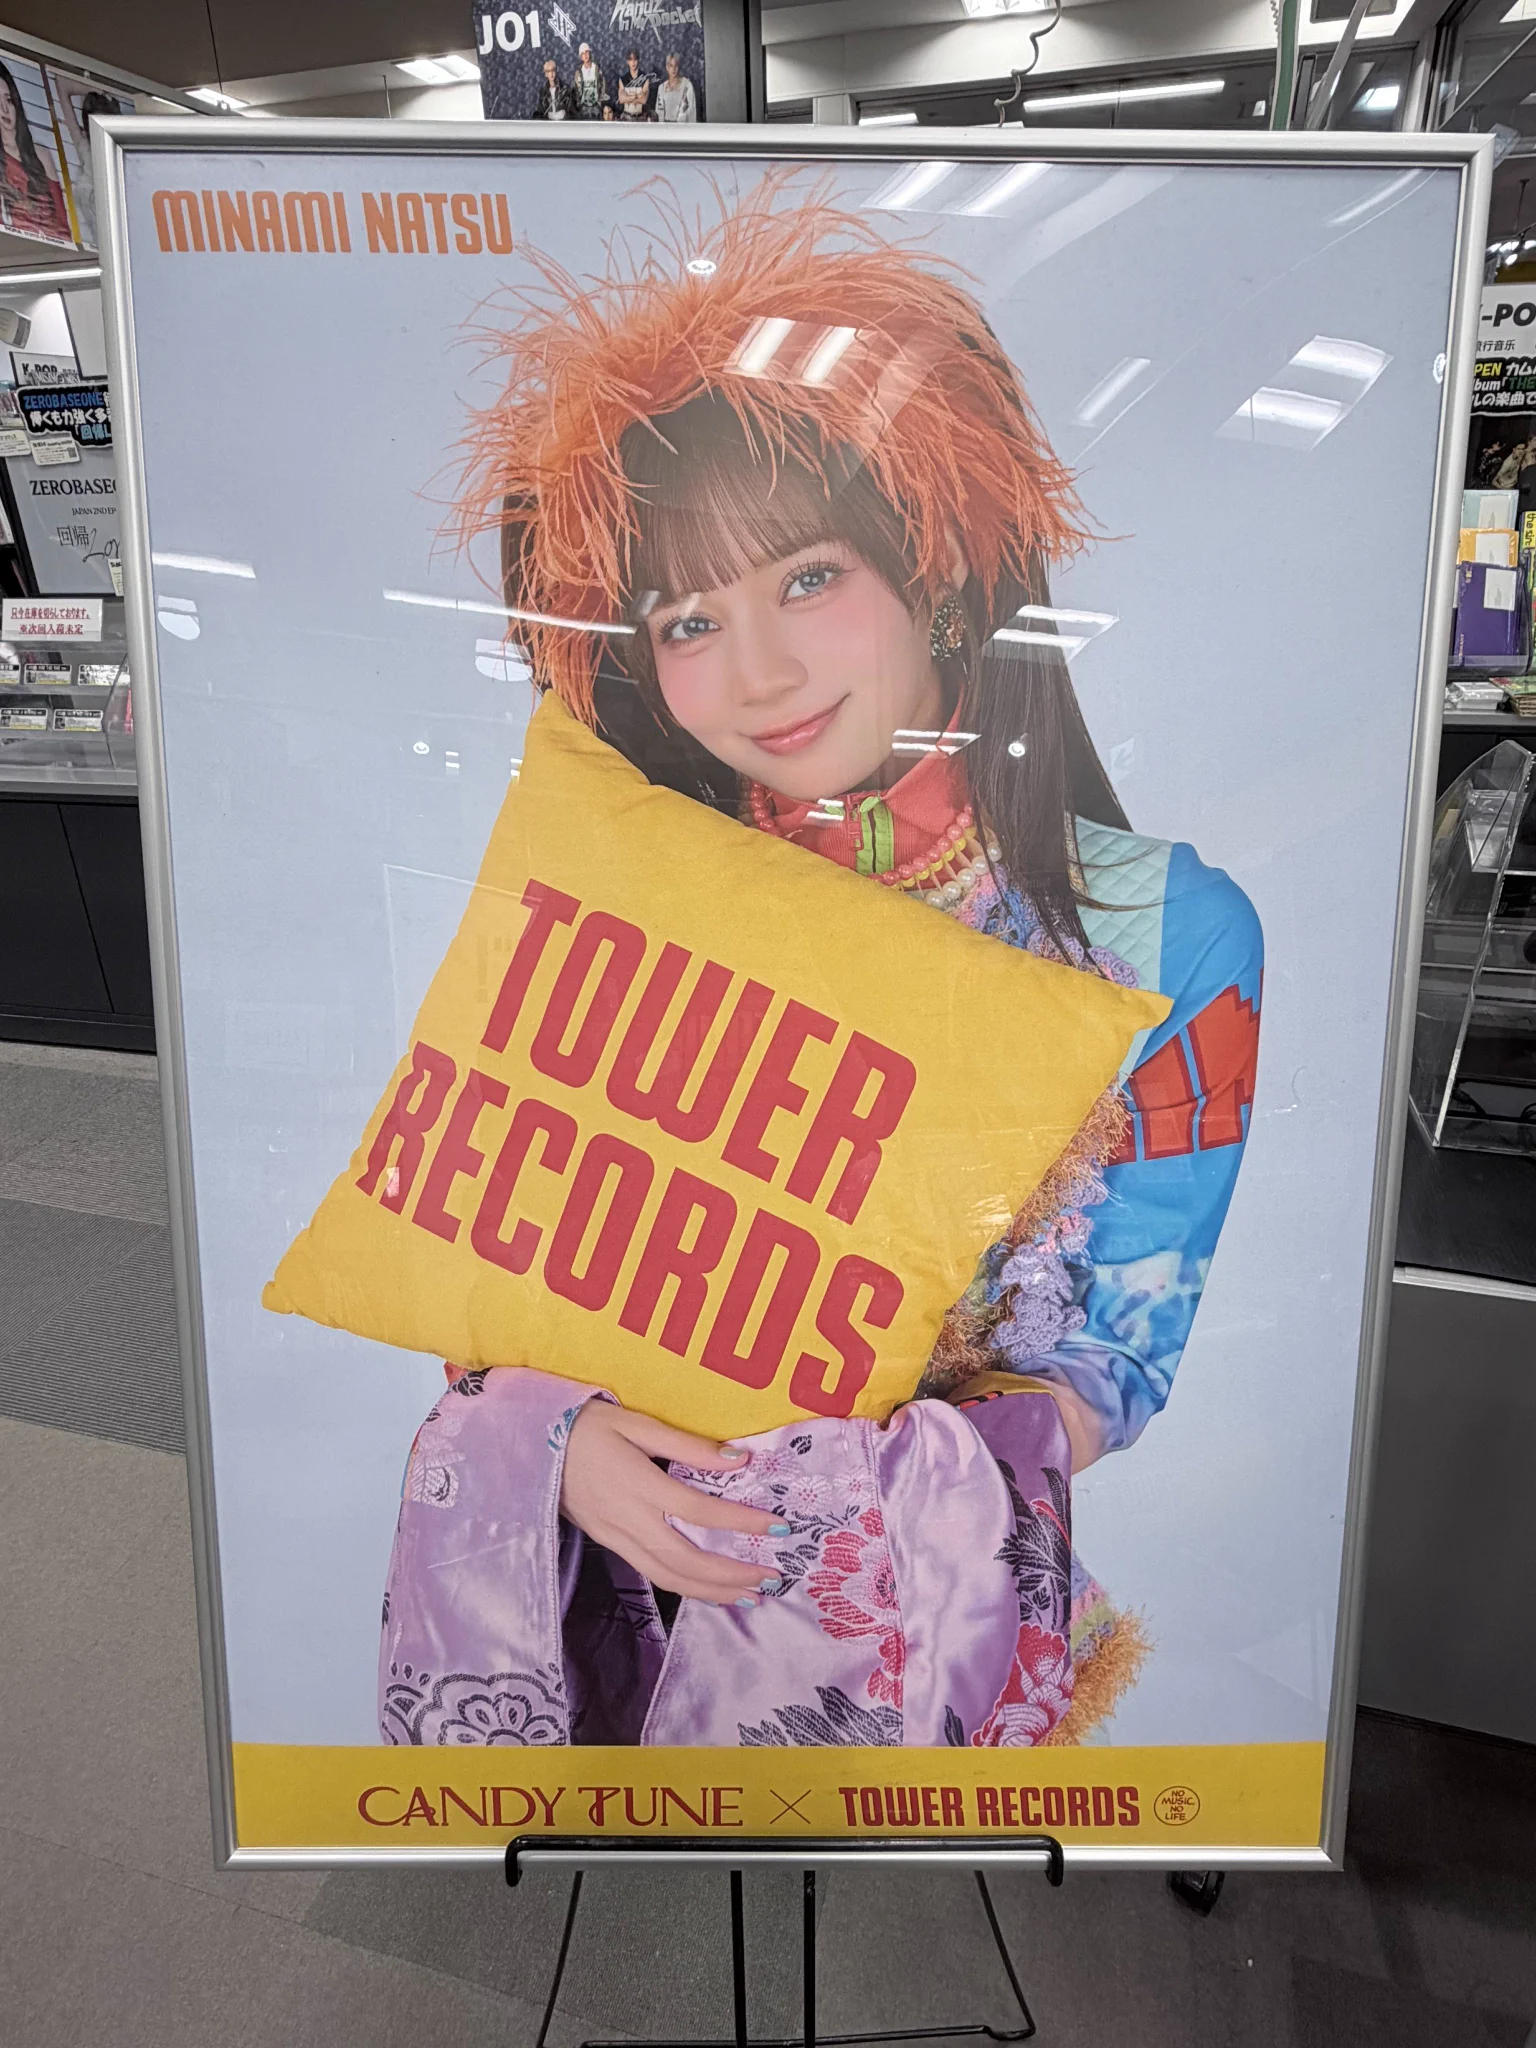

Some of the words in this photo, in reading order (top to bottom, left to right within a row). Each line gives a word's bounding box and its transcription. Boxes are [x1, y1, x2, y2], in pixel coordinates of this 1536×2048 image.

[479, 10, 541, 55] JO1
[152, 190, 351, 252] MINAMI
[361, 192, 513, 254] NATSU
[1481, 302, 1536, 327] -PO
[1474, 362, 1502, 376] PEN
[1506, 361, 1536, 376] カム
[480, 878, 917, 1225] TOWER
[355, 1041, 905, 1418] RECORDS
[358, 1786, 566, 1827] CANDY
[578, 1786, 744, 1827] TUNE
[838, 1786, 965, 1827] TOWER
[976, 1786, 1140, 1827] RECORDS
